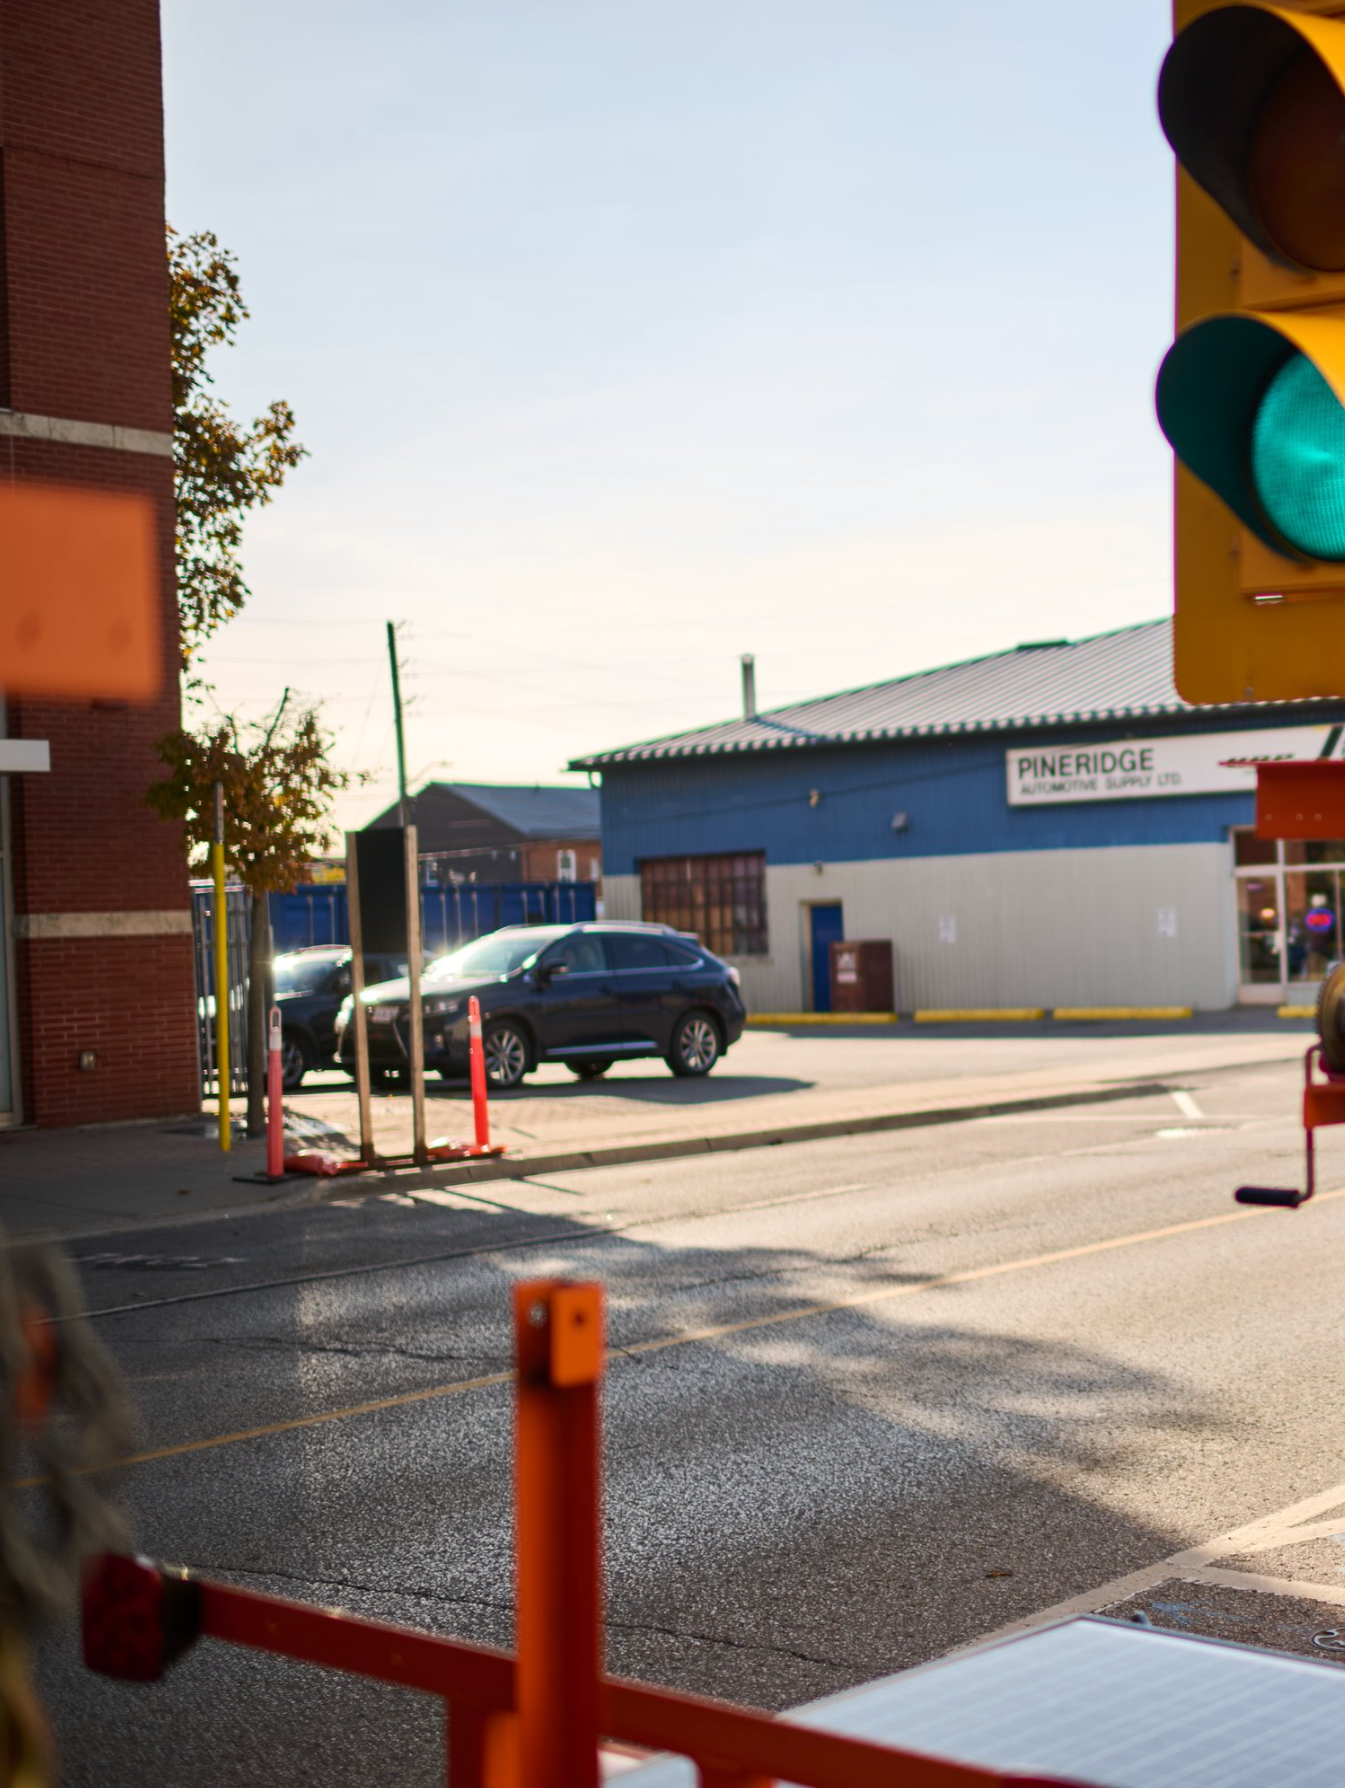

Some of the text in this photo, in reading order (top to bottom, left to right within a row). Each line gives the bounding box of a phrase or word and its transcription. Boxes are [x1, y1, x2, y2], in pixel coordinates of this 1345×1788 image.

[1018, 748, 1154, 779] PINERIDGE
[1020, 778, 1098, 795] AUTOMOTIVE
[1105, 775, 1151, 790] SUPPLY
